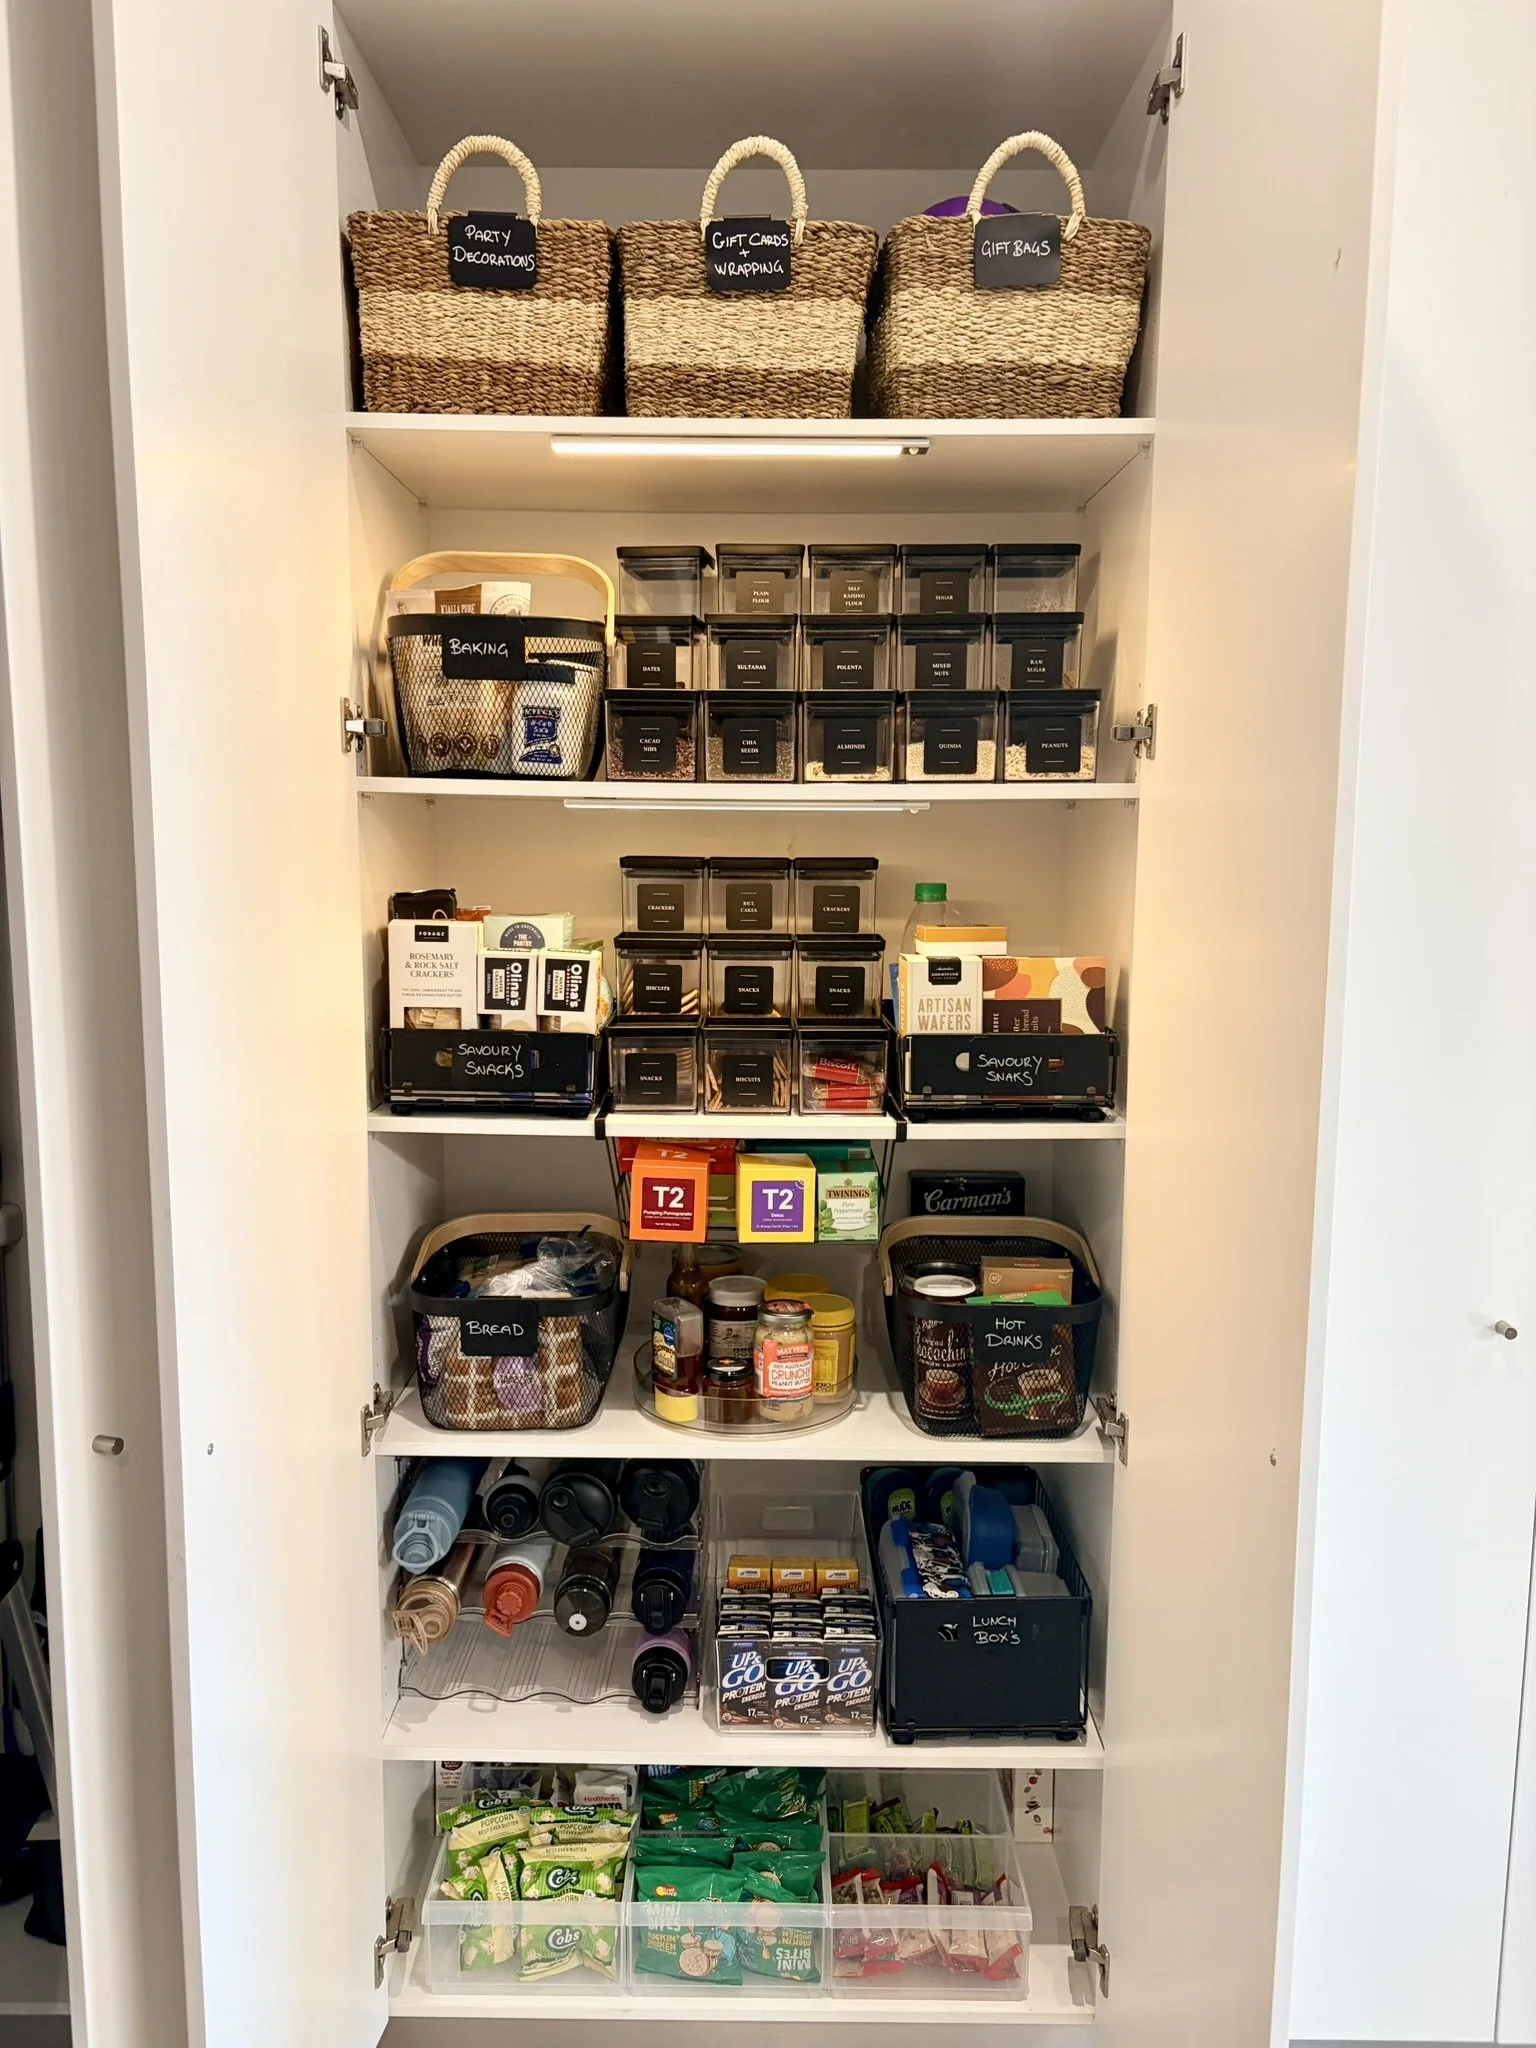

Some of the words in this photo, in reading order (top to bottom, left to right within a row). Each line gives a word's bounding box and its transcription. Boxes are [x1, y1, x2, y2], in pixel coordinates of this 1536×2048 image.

[464, 224, 511, 247] PARTY
[712, 232, 747, 249] GIFT
[748, 233, 789, 247] CARDS
[739, 248, 750, 258] +
[981, 240, 1011, 258] GIFT
[1012, 240, 1051, 257] BAGS
[452, 245, 535, 272] DECORATIONS
[714, 260, 784, 278] WRAPPING
[461, 603, 477, 614] PURE
[448, 638, 509, 659] BAKING
[409, 952, 455, 961] ROSEMARY
[404, 961, 412, 969] &
[439, 962, 459, 970] SALT
[410, 970, 455, 978] CRACKERS
[510, 962, 523, 1007] Olina's
[569, 964, 583, 1008] Olina's
[918, 998, 972, 1013] ARTISAN
[918, 1014, 972, 1031] WAFERS
[457, 1043, 522, 1062] SAVOURY
[464, 1060, 525, 1080] SNACKS
[819, 1057, 857, 1071] Biscoff
[976, 1054, 1043, 1076] SAVOURY
[986, 1070, 1034, 1087] SNAKS
[656, 1148, 688, 1160] T2
[652, 1186, 685, 1209] T2
[762, 1188, 794, 1211] T2
[827, 1189, 871, 1198] TWININGS
[924, 1186, 1012, 1213] Carman's
[466, 1321, 525, 1337] BREAD
[995, 1317, 1026, 1331] HOT
[984, 1333, 1043, 1350] DRINKS
[771, 1368, 811, 1380] CRUNCHY
[892, 1500, 913, 1513] NUDE
[776, 1584, 810, 1594] SUSTAGEN
[972, 1616, 1017, 1628] LUNCH
[973, 1630, 1021, 1645] BOX'S
[722, 1664, 765, 1689] GO
[775, 1672, 821, 1696] GO
[827, 1669, 873, 1692] GO
[722, 1681, 767, 1703] PROTEIN
[774, 1690, 820, 1709] PROTEIN
[826, 1686, 872, 1704] PROTEIN
[584, 1795, 620, 1803] Healtheries
[478, 1826, 490, 1836] BEST
[490, 1824, 501, 1833] EVER
[501, 1820, 519, 1829] BUTTER
[480, 1813, 514, 1828] POPCORN
[548, 1868, 580, 1888] Cobs
[647, 1903, 681, 1917] MINI
[548, 1929, 580, 1950] Cobs
[776, 1948, 811, 1960] BITES
[777, 1958, 812, 1971] MINI
